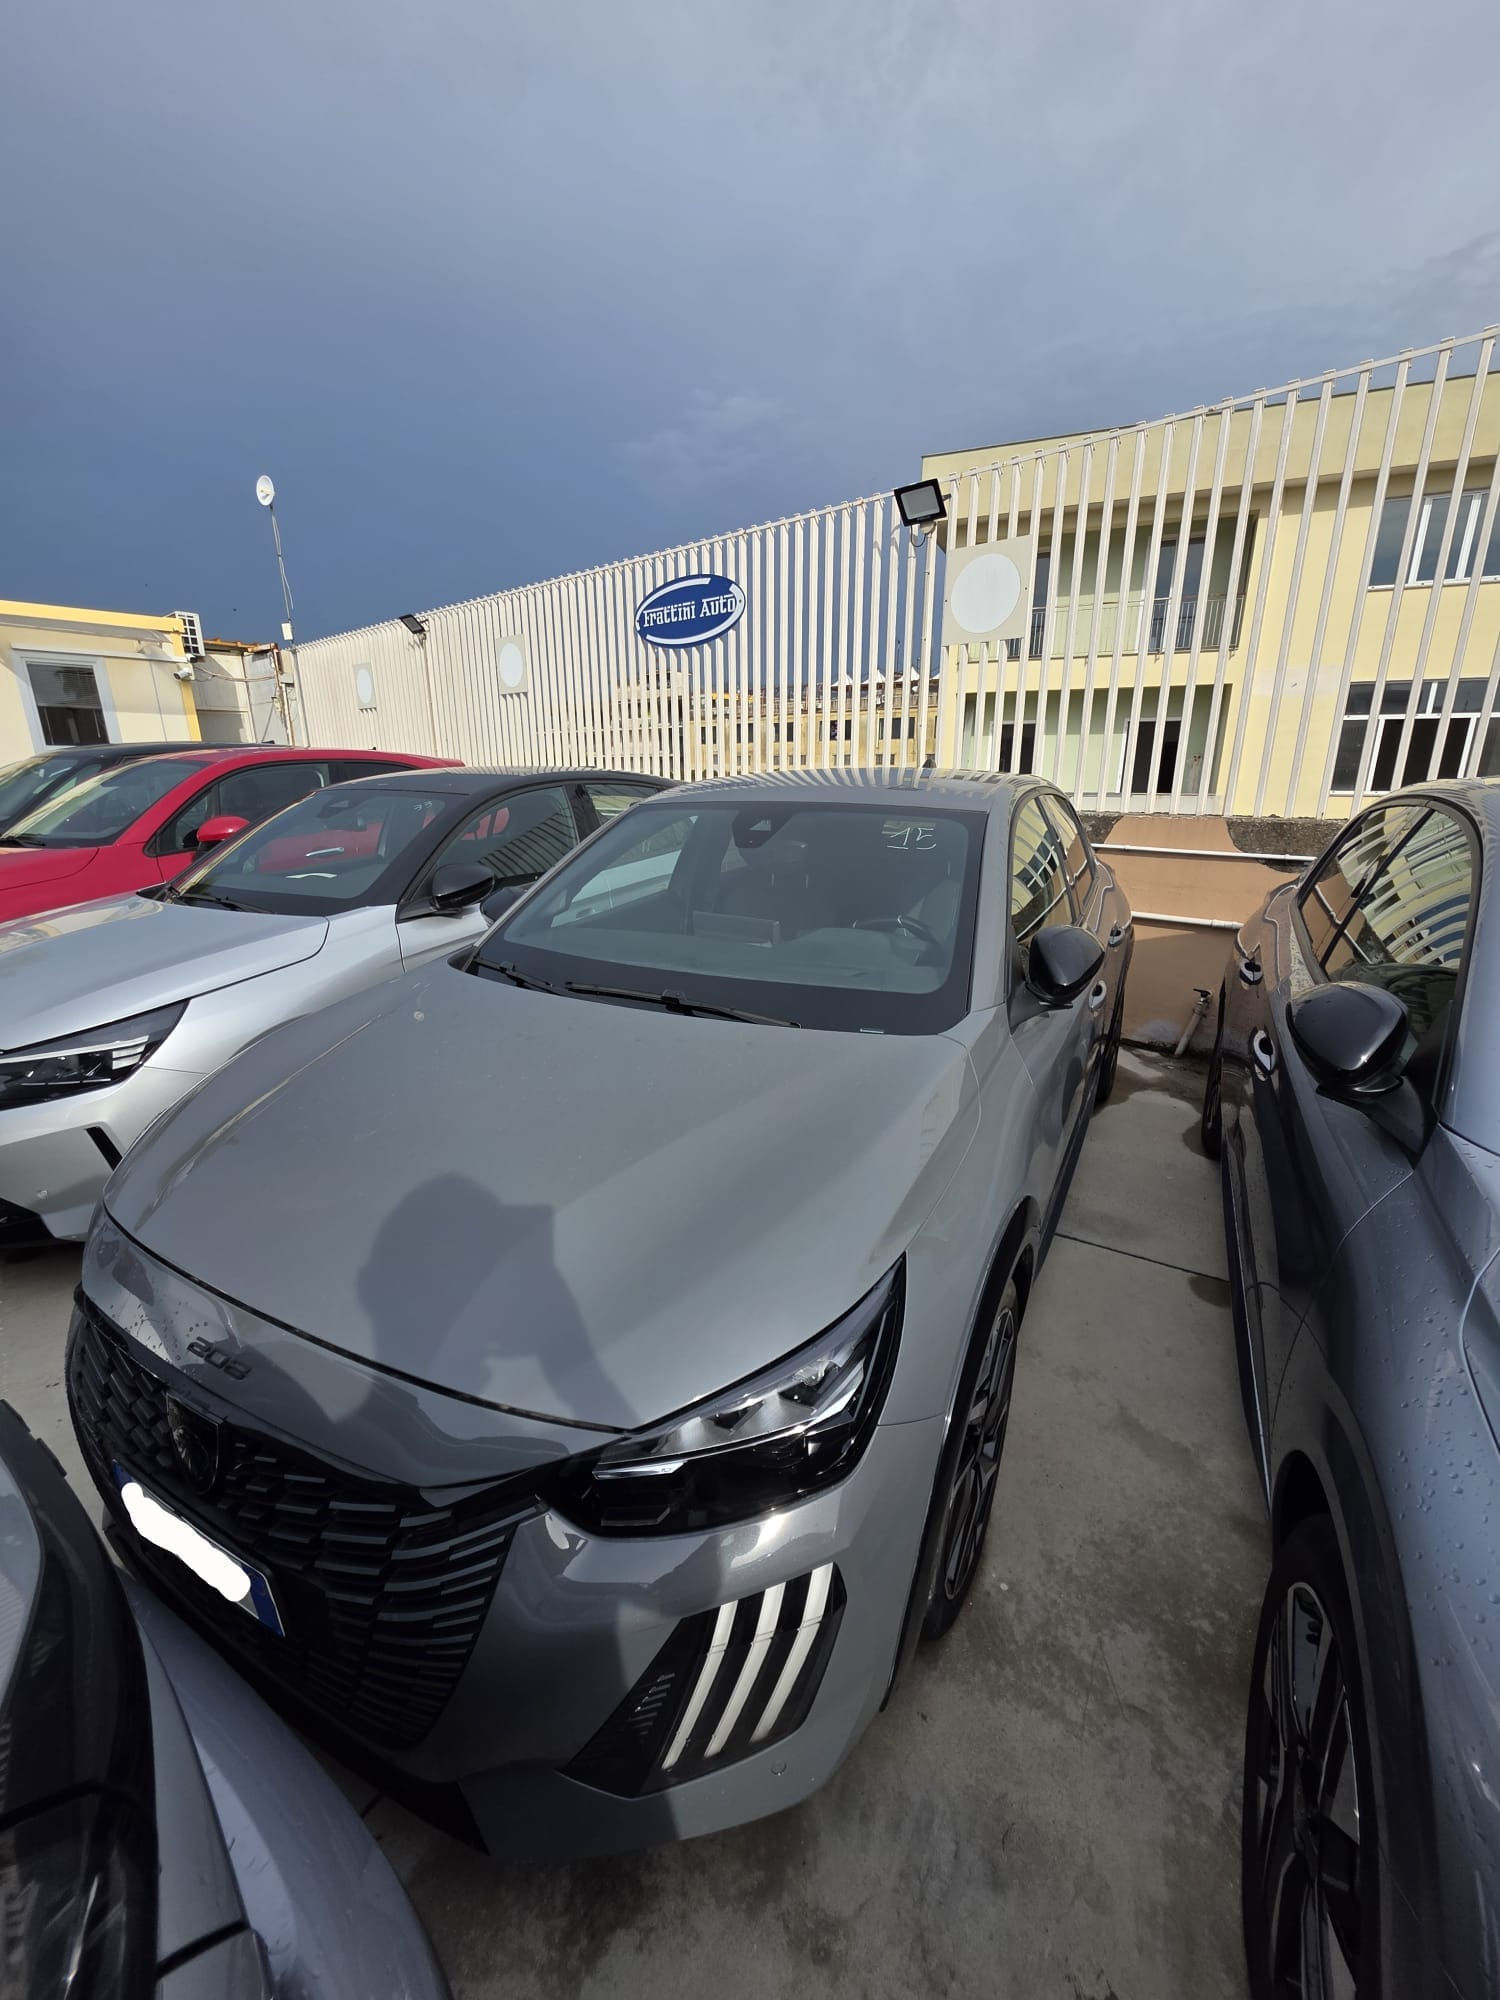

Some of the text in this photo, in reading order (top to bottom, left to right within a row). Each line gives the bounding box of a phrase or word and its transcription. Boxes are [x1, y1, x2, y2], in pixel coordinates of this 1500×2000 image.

[643, 594, 736, 627] Frattini Auto
[187, 1336, 252, 1380] 208
